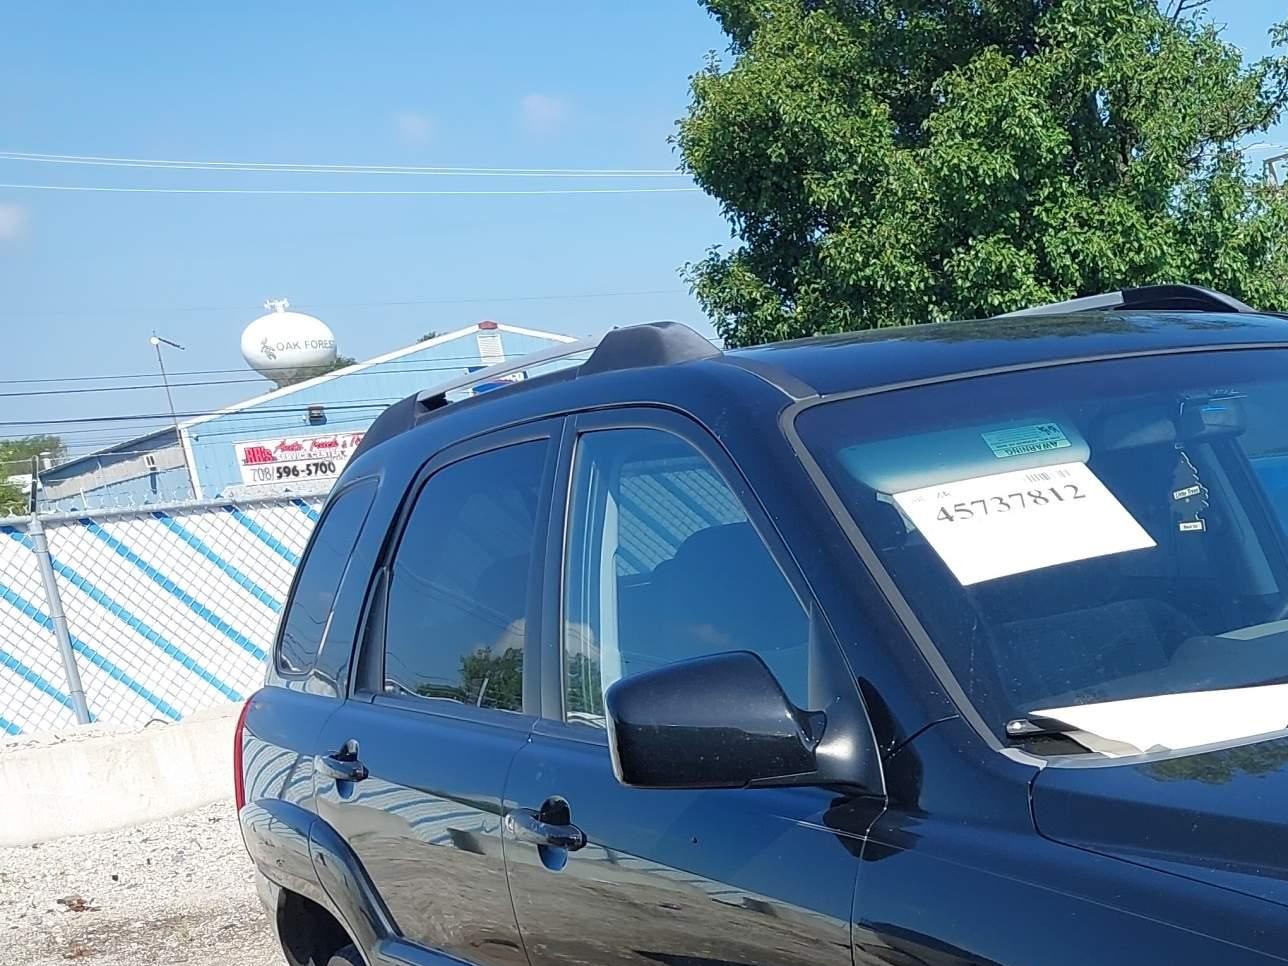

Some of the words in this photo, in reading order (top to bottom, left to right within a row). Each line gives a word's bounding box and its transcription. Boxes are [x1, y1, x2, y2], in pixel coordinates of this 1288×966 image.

[276, 341, 301, 352] OAK
[304, 339, 335, 350] FORES
[1004, 442, 1051, 455] WARNING
[251, 462, 336, 482] 708/596-5700
[936, 485, 1086, 522] 45737812
